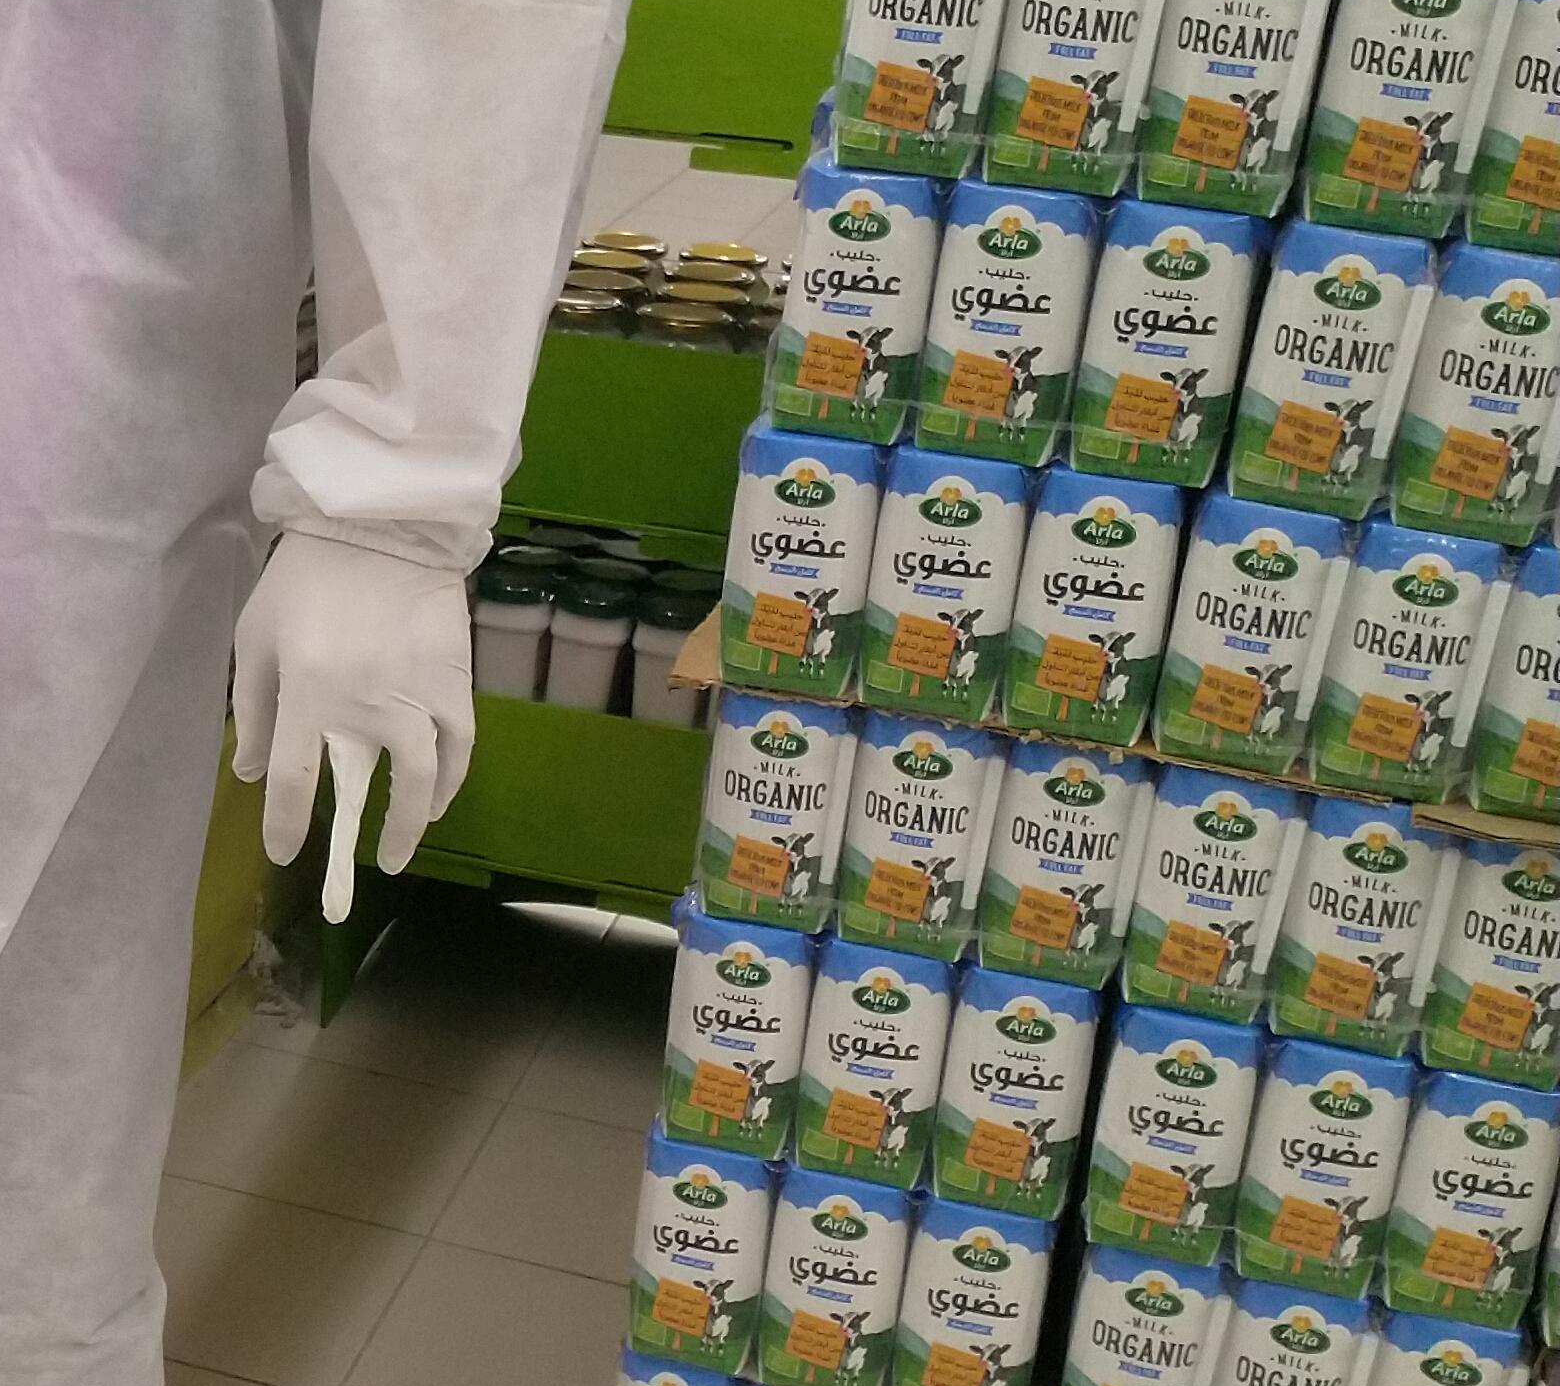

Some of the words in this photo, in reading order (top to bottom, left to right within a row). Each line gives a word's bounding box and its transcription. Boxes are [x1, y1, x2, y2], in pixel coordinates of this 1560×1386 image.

[1177, 16, 1299, 63] ORGANIC
[1349, 36, 1475, 85] ORGANIC
[839, 214, 879, 234] Arla
[835, 250, 876, 263] حليب
[803, 265, 902, 304] عضوي
[951, 283, 1052, 322] عضوي
[1325, 283, 1368, 303] Arla
[1114, 303, 1219, 344] عضوي
[1320, 314, 1361, 334] MILK
[1273, 323, 1396, 375] ORGANIC
[1439, 348, 1560, 400] ORGANIC
[785, 481, 824, 502] Arla
[781, 514, 821, 528] حليب
[750, 528, 847, 566] عضوي
[1244, 554, 1286, 575] Arla
[892, 548, 993, 586] عضوي
[1042, 568, 1145, 608] عضوي
[1195, 589, 1314, 641] ORGANIC
[1352, 616, 1473, 668] ORGANIC
[759, 760, 798, 778] MILK
[902, 755, 942, 775] Arla
[724, 768, 828, 813] ORGANIC
[864, 788, 970, 836] ORGANIC
[1010, 814, 1121, 863] ORGANIC
[1158, 849, 1273, 899] ORGANIC
[1308, 880, 1424, 931] ORGANIC
[861, 989, 900, 1009] Arla
[692, 1003, 782, 1036] عضوي
[969, 1057, 1066, 1093] عضوي
[1128, 1103, 1224, 1138] عضوي
[1432, 1165, 1535, 1200] عضوي
[652, 1223, 740, 1256] عضوي
[927, 1285, 1021, 1320] عضوي
[1092, 1319, 1198, 1369] ORGANIC
